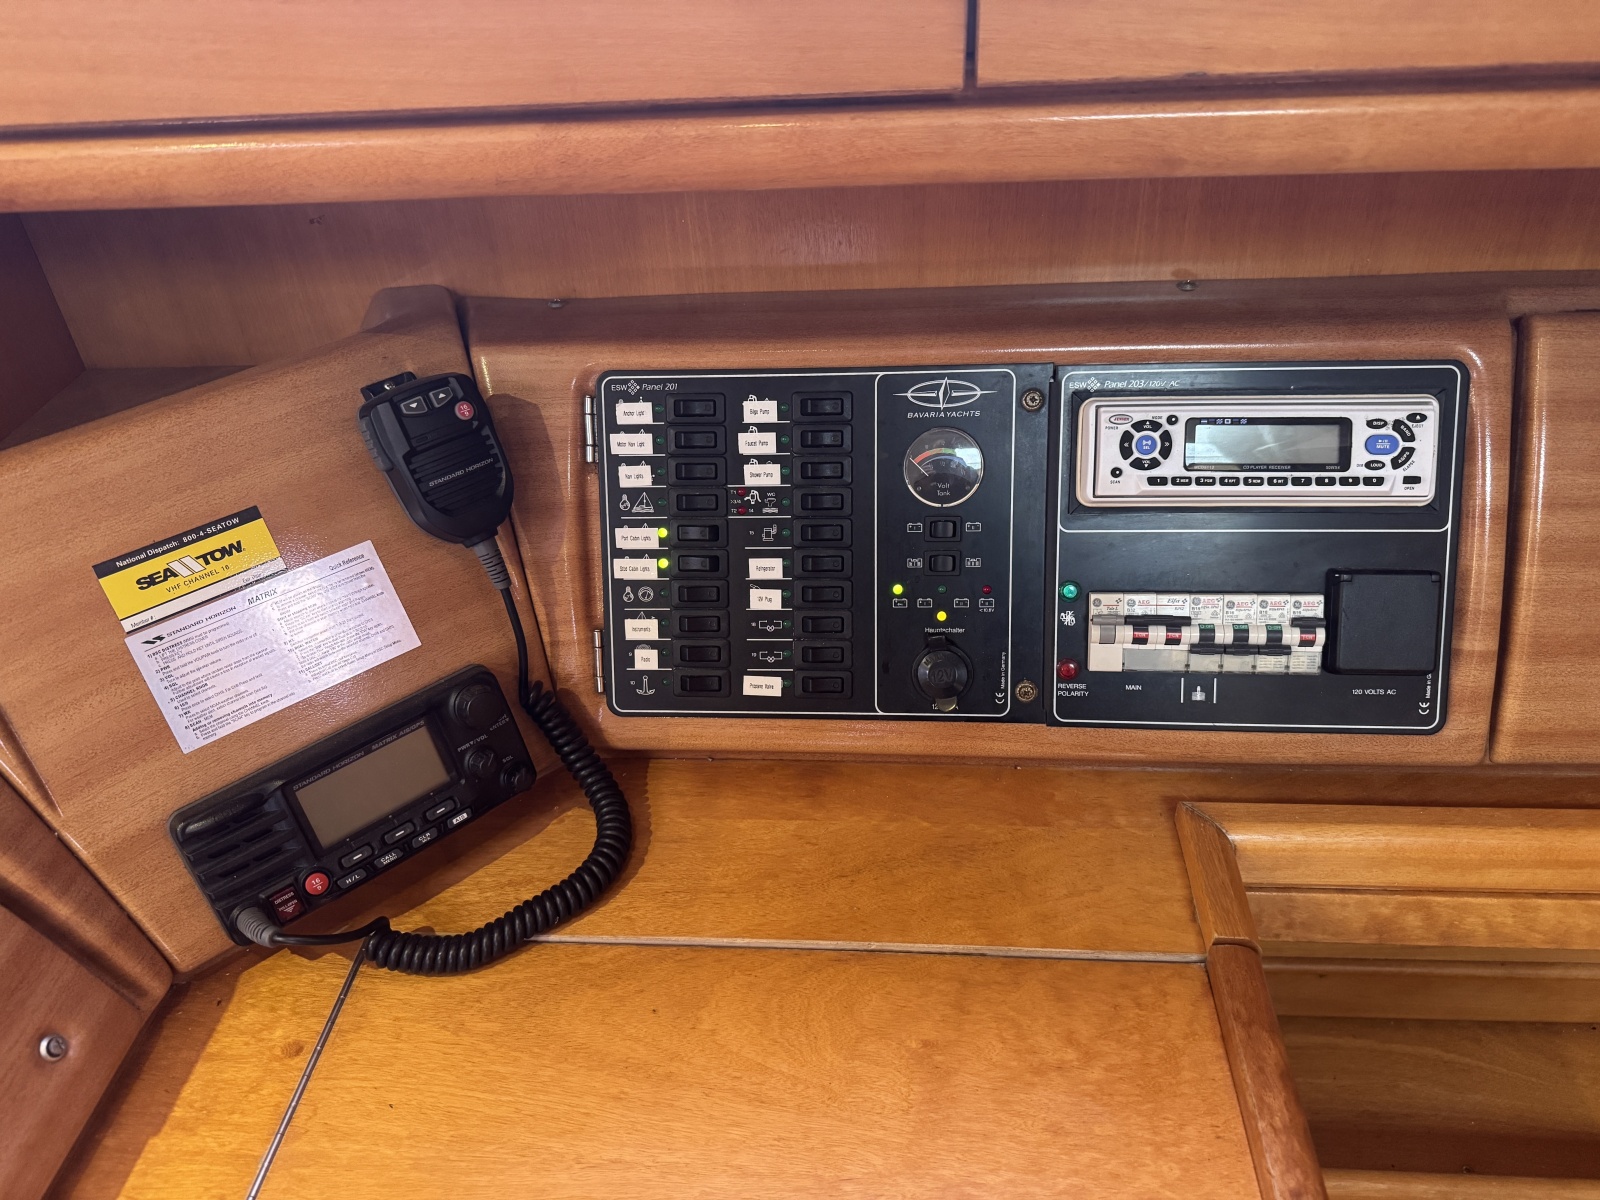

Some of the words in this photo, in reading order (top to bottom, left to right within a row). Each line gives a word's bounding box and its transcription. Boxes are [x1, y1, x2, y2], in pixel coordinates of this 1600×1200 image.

[1104, 380, 1126, 388] Panel
[1400, 425, 1411, 437] BAND
[1403, 460, 1415, 472] ELAPSE
[429, 470, 465, 487] STANDARD
[465, 458, 494, 473] HORIZON
[115, 552, 146, 568] National
[146, 540, 180, 557] Dispatch:
[182, 517, 240, 543] 800-4-SEATOW
[135, 568, 179, 591] SEA
[194, 540, 243, 567] TOW
[328, 561, 343, 571] Quick
[342, 553, 365, 566] Reference
[165, 583, 181, 593] VHF
[183, 569, 220, 587] CHANNEL
[247, 588, 278, 606] MATRIX
[130, 618, 150, 628] Member
[166, 619, 204, 638] STANDARD
[205, 606, 237, 621] HORIZON
[292, 768, 331, 791] STANDARD
[332, 750, 365, 771] HORIZON
[371, 733, 398, 750] MATRIX
[502, 755, 514, 763] SQL
[453, 813, 467, 824] AIS
[418, 832, 431, 841] CLR
[380, 852, 396, 862] CALL
[311, 877, 321, 885] 16
[346, 874, 360, 884] H/L
[274, 891, 295, 905] DISTRESS
